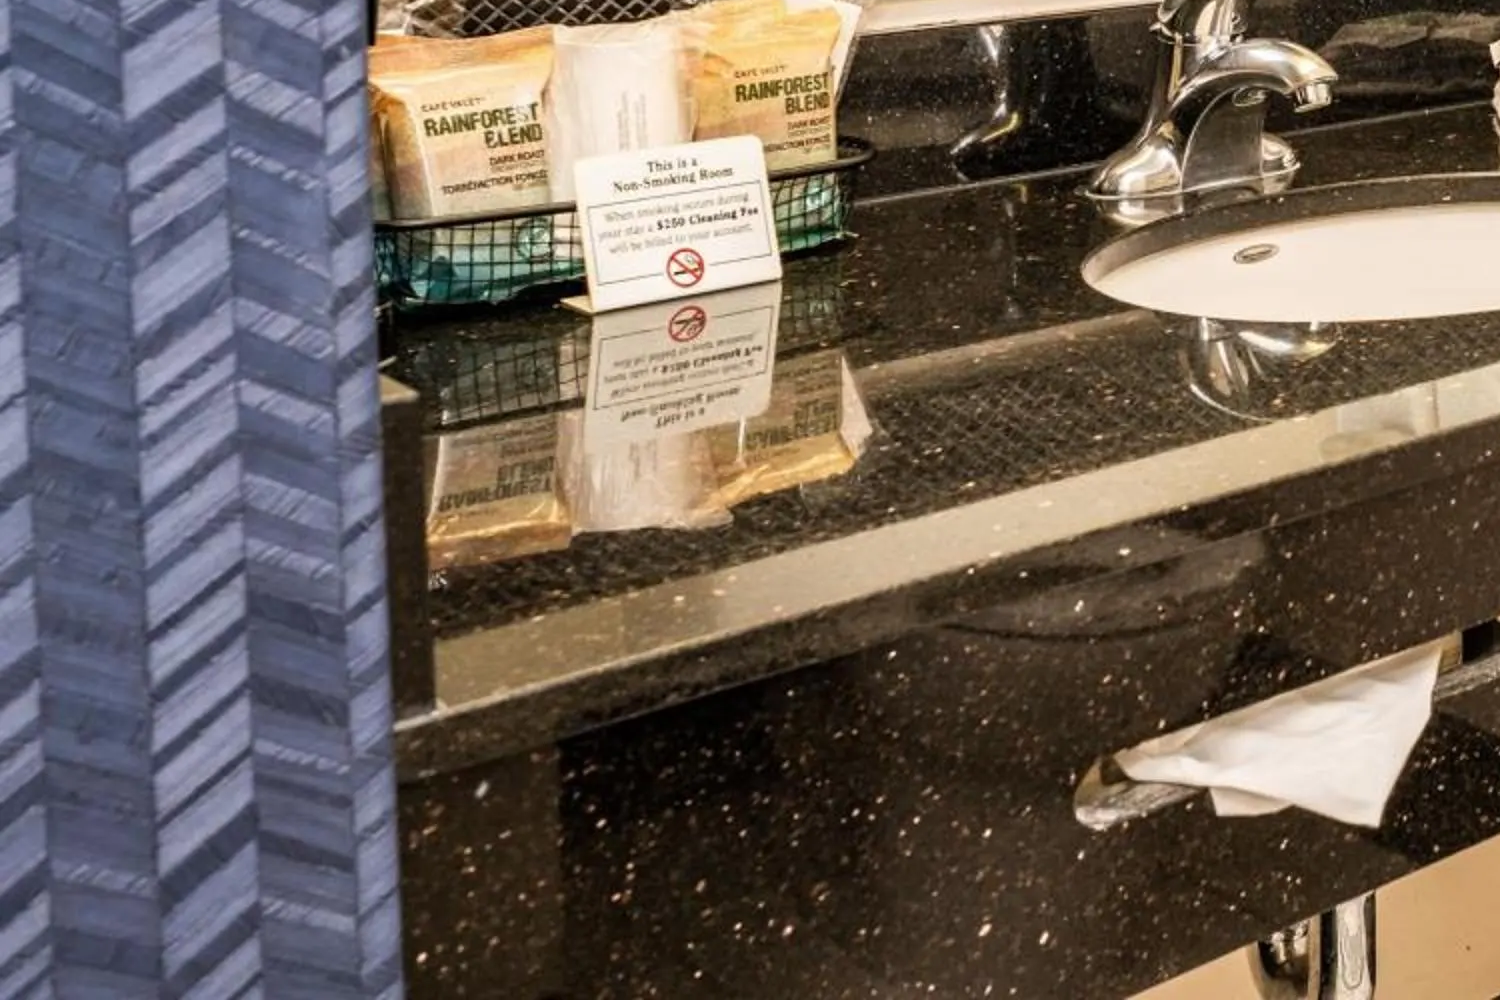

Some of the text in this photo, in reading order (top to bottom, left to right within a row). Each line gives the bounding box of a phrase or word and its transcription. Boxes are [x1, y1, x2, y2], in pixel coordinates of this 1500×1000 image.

[735, 72, 829, 103] RAINFOREST
[785, 91, 830, 115] BLEND
[423, 102, 539, 137] RAINFOREST
[484, 123, 543, 149] BLEND
[489, 155, 514, 167] DARK
[647, 157, 698, 173] This is a
[613, 167, 733, 193] Non-Smoking Room
[656, 218, 685, 231] $250
[689, 208, 738, 225] Cleaning
[740, 206, 759, 217] Fee
